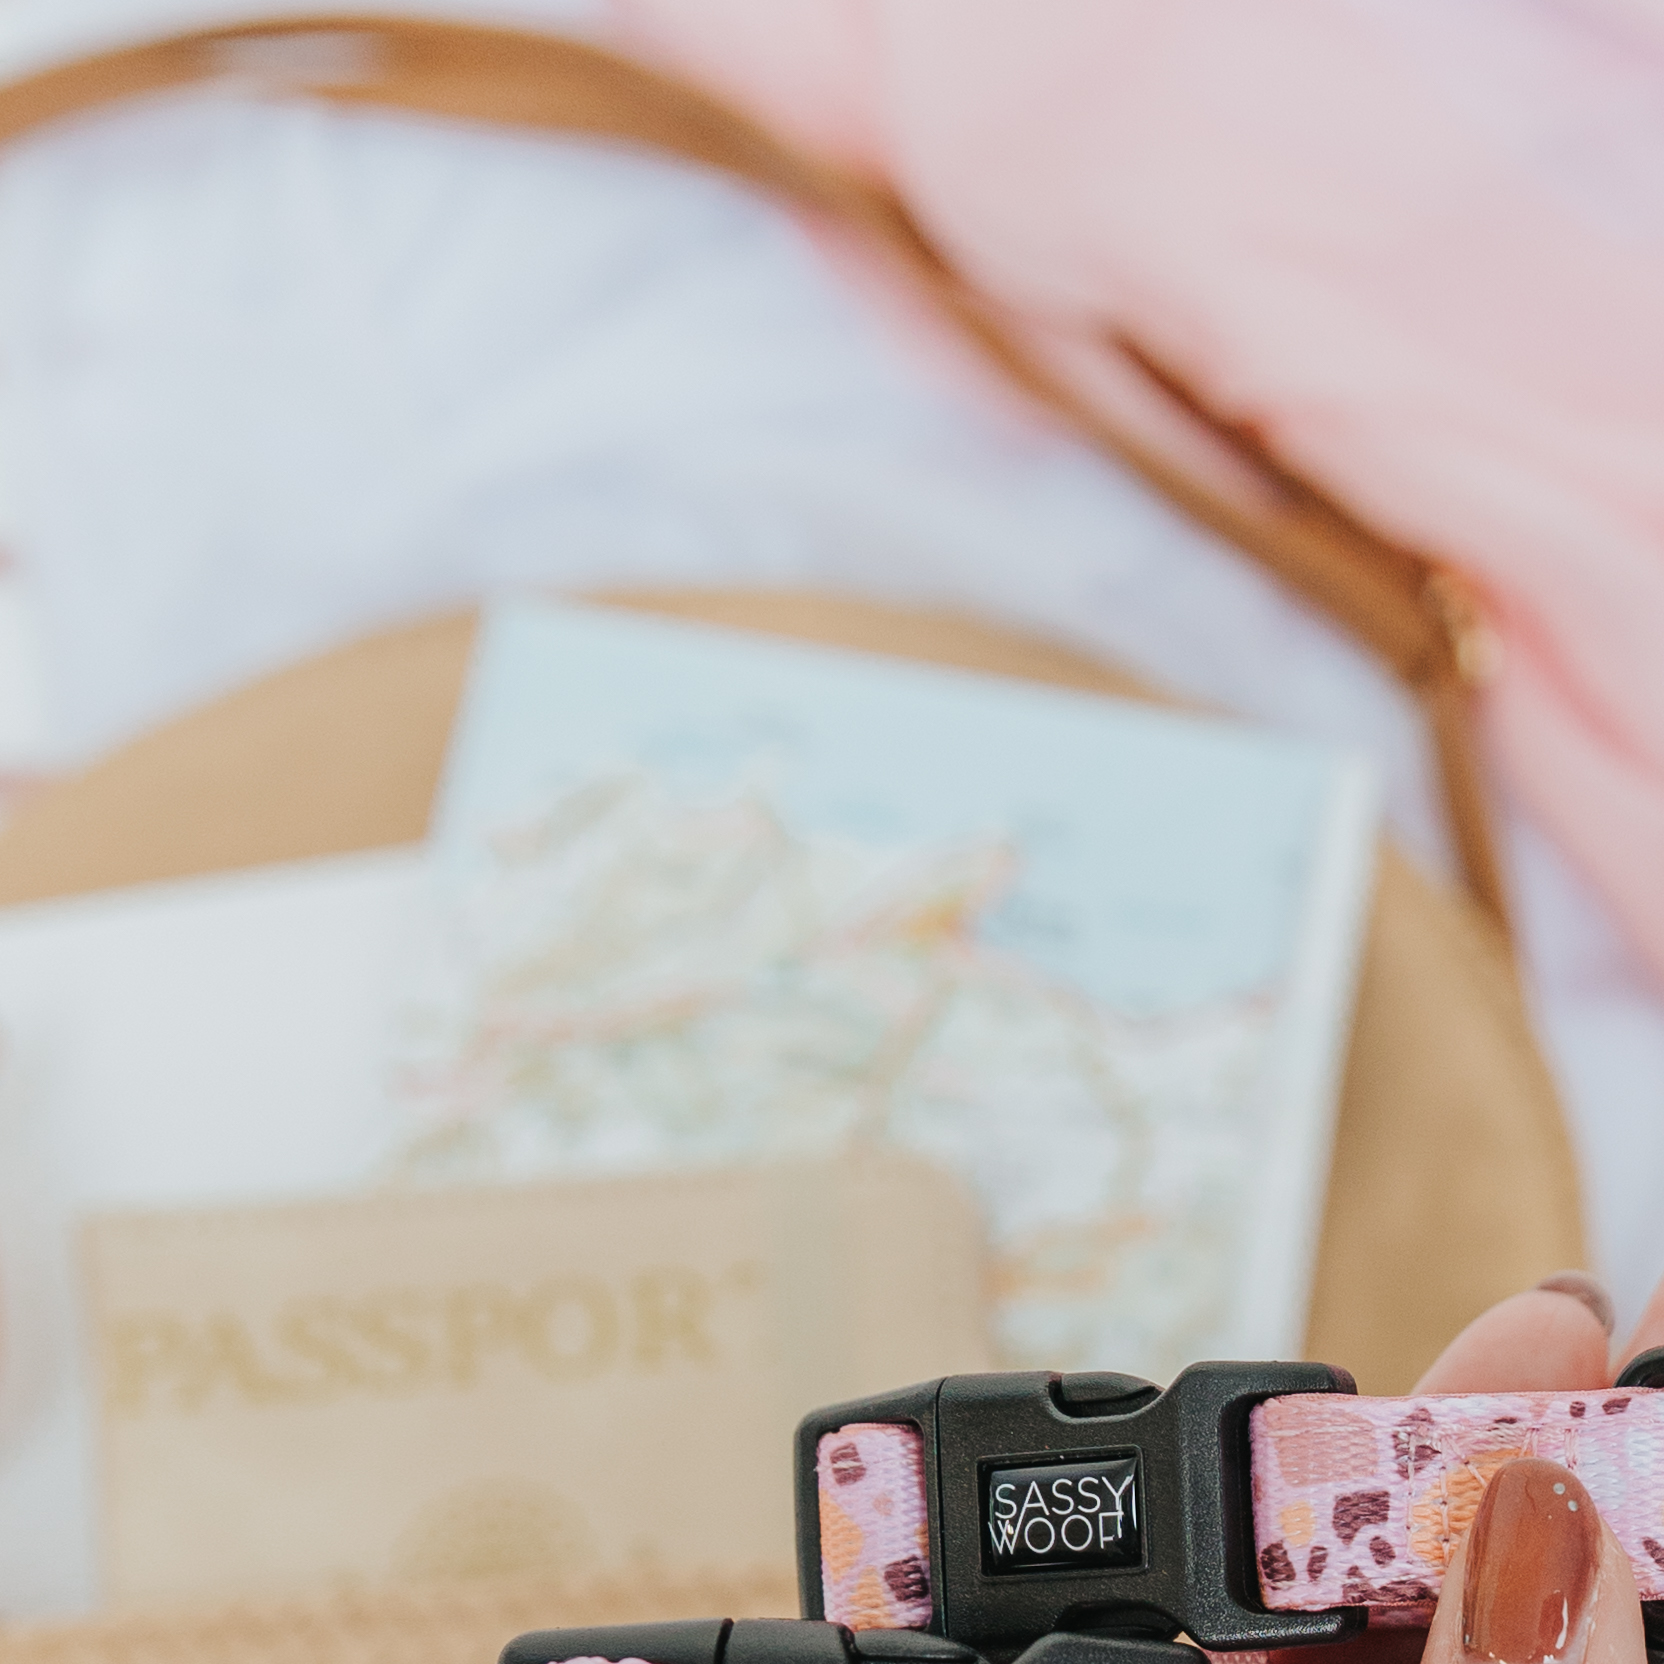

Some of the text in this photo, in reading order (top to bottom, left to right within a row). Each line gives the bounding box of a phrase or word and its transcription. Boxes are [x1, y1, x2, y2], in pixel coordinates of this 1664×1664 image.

[110, 1258, 764, 1418] PASSPOR
[994, 1476, 1134, 1519] SASSY
[988, 1511, 1124, 1555] WOOF
